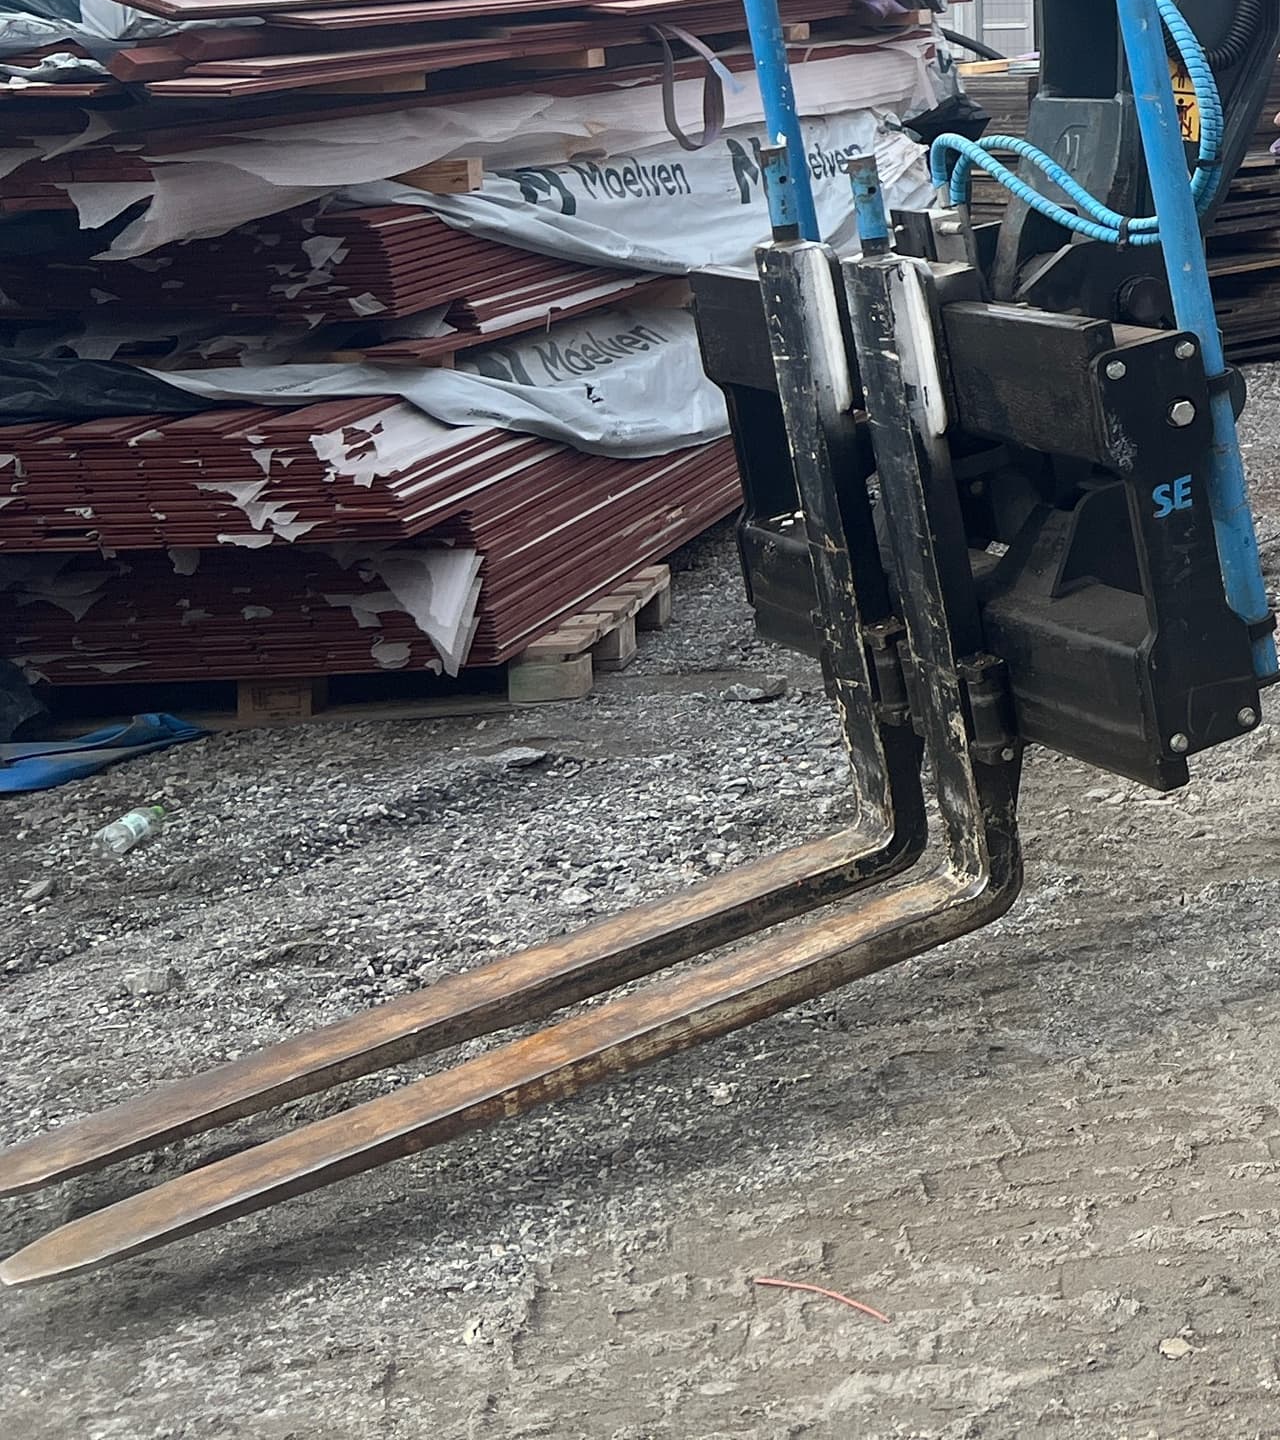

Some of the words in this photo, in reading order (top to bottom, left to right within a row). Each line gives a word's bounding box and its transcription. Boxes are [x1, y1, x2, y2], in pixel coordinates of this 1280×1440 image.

[571, 158, 691, 200] Moelven
[532, 324, 669, 382] Moelven
[1152, 474, 1193, 518] SE
